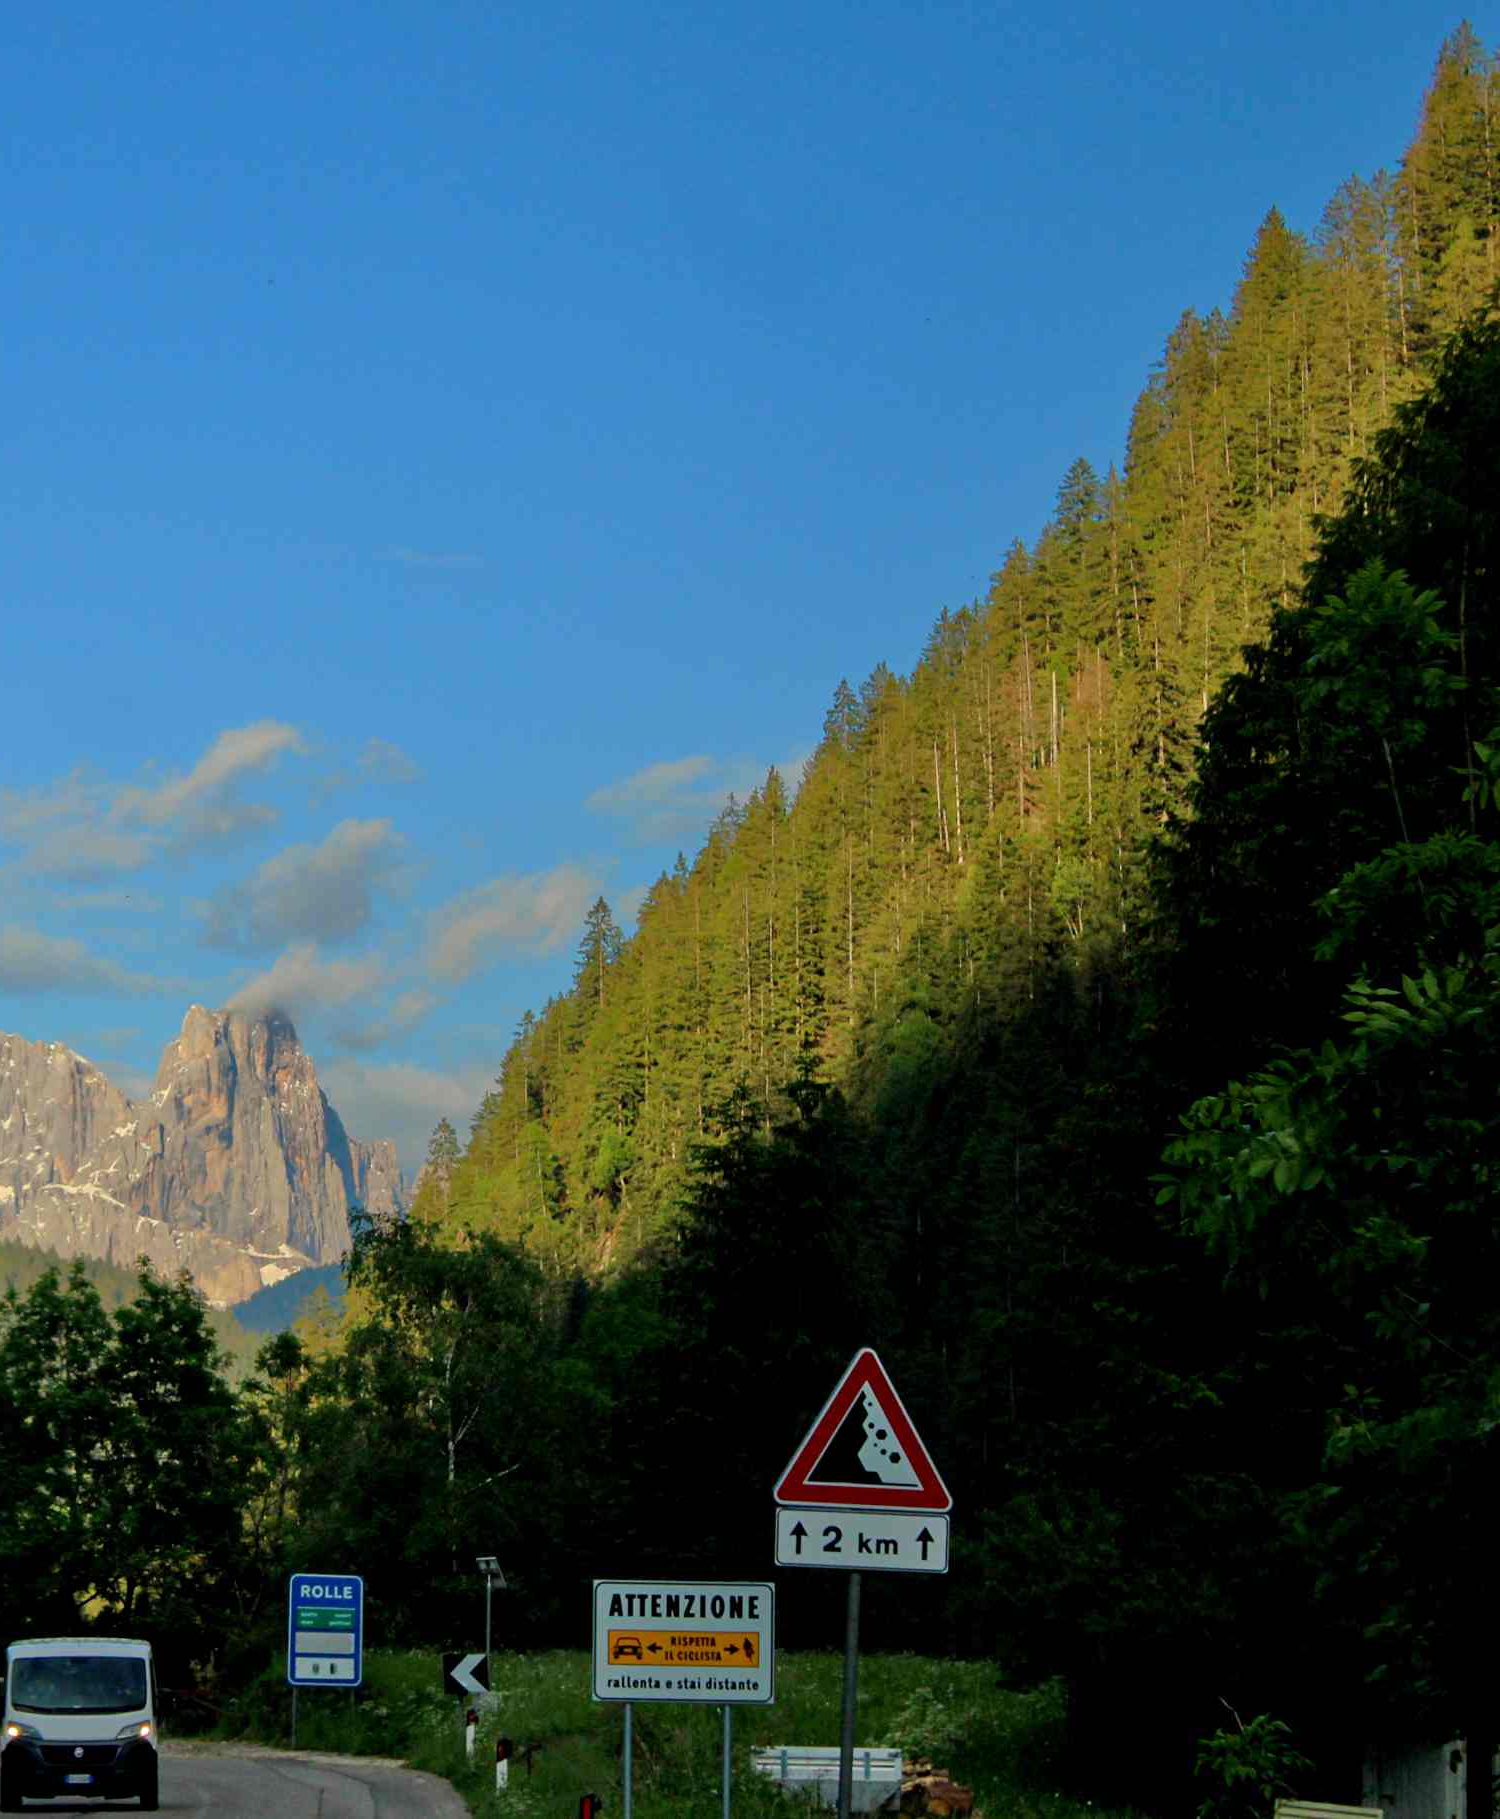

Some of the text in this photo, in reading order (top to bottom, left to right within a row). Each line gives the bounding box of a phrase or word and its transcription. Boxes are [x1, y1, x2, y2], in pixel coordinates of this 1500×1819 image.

[822, 1525, 899, 1555] 2 km
[300, 1584, 353, 1599] ROLLE
[608, 1593, 760, 1619] ATTENZIONE
[670, 1636, 717, 1648] RISPETTA
[664, 1650, 722, 1662] IL CICLISTA
[607, 1675, 759, 1691] rallenta e stai distante
